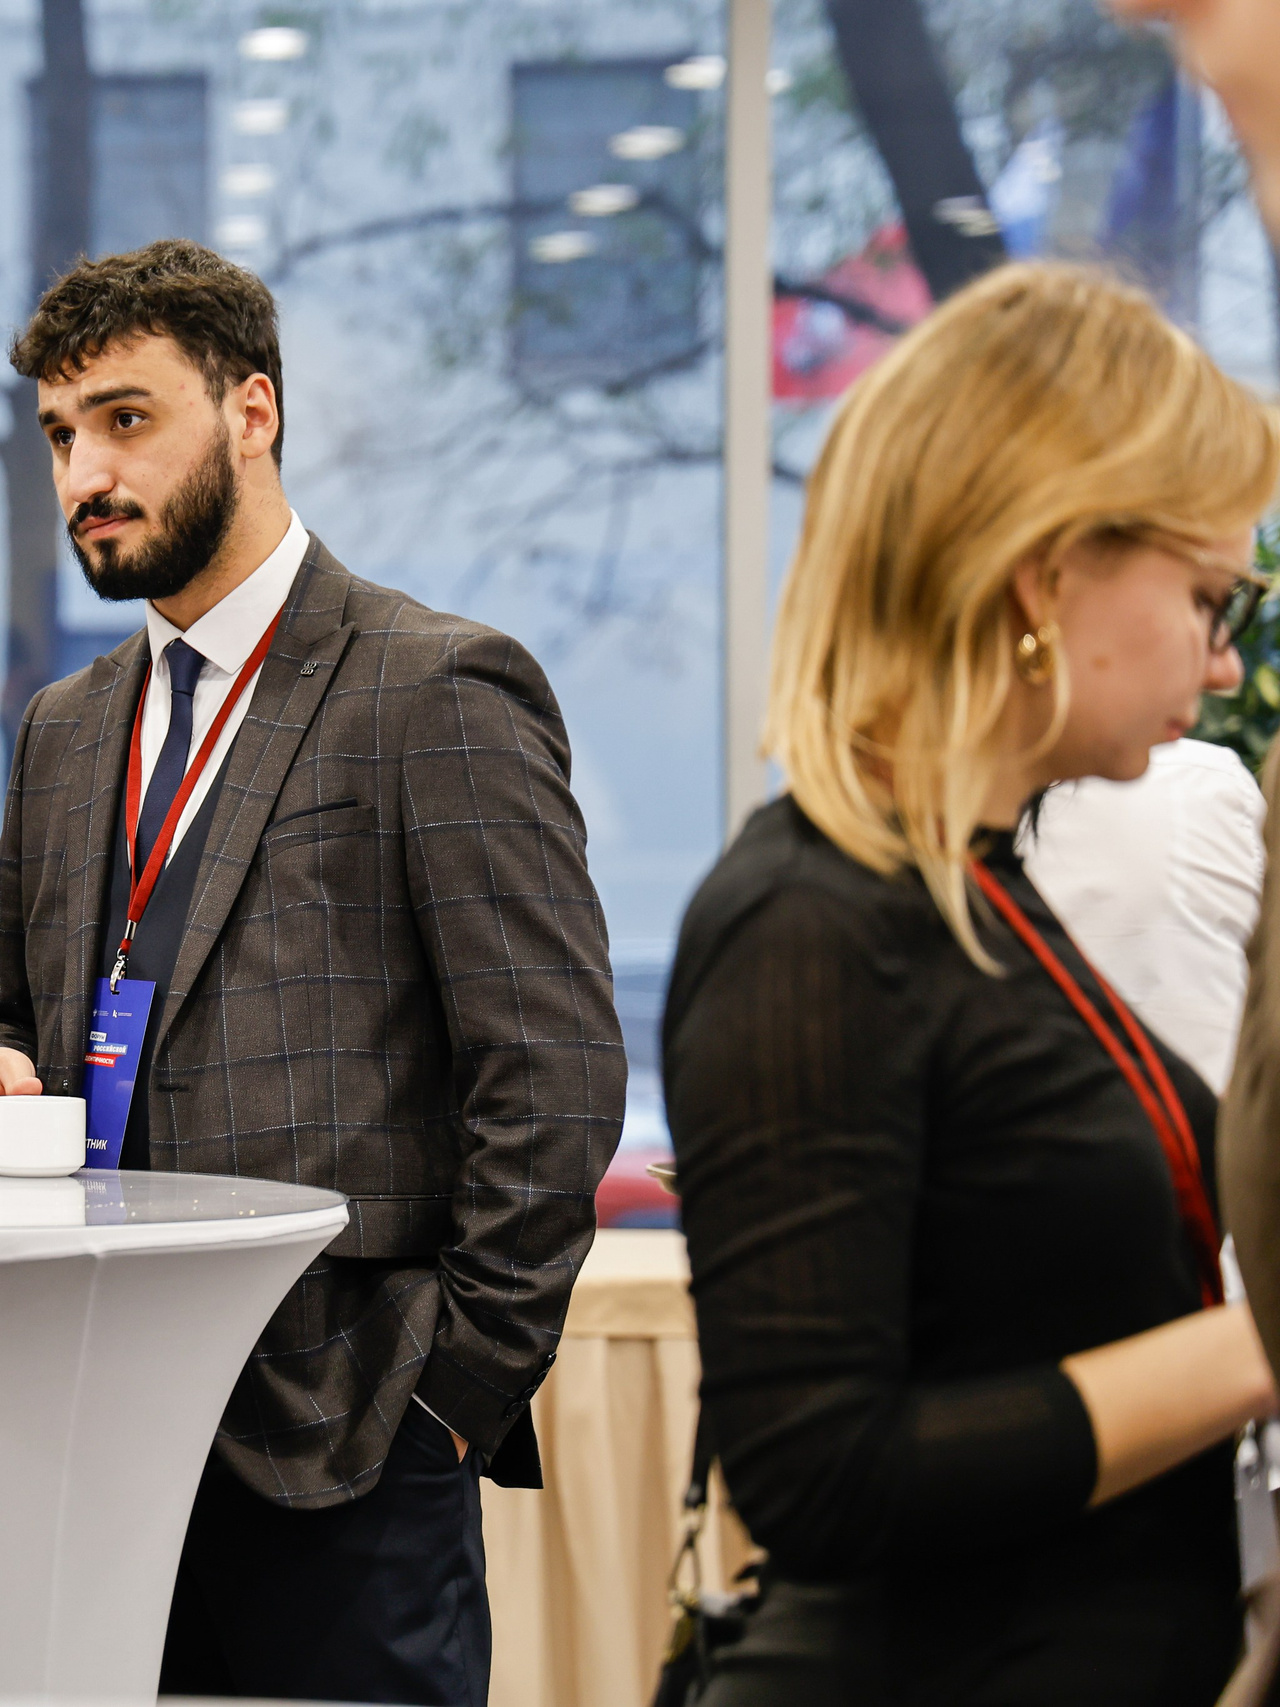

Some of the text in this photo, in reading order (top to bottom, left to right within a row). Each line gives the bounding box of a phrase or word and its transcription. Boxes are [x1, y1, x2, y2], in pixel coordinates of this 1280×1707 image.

[93, 1044, 127, 1054] РОССИЙСКОЙ
[84, 1055, 115, 1065] ДЕНТИЧНОСТИ
[86, 1138, 108, 1150] ТНИК
